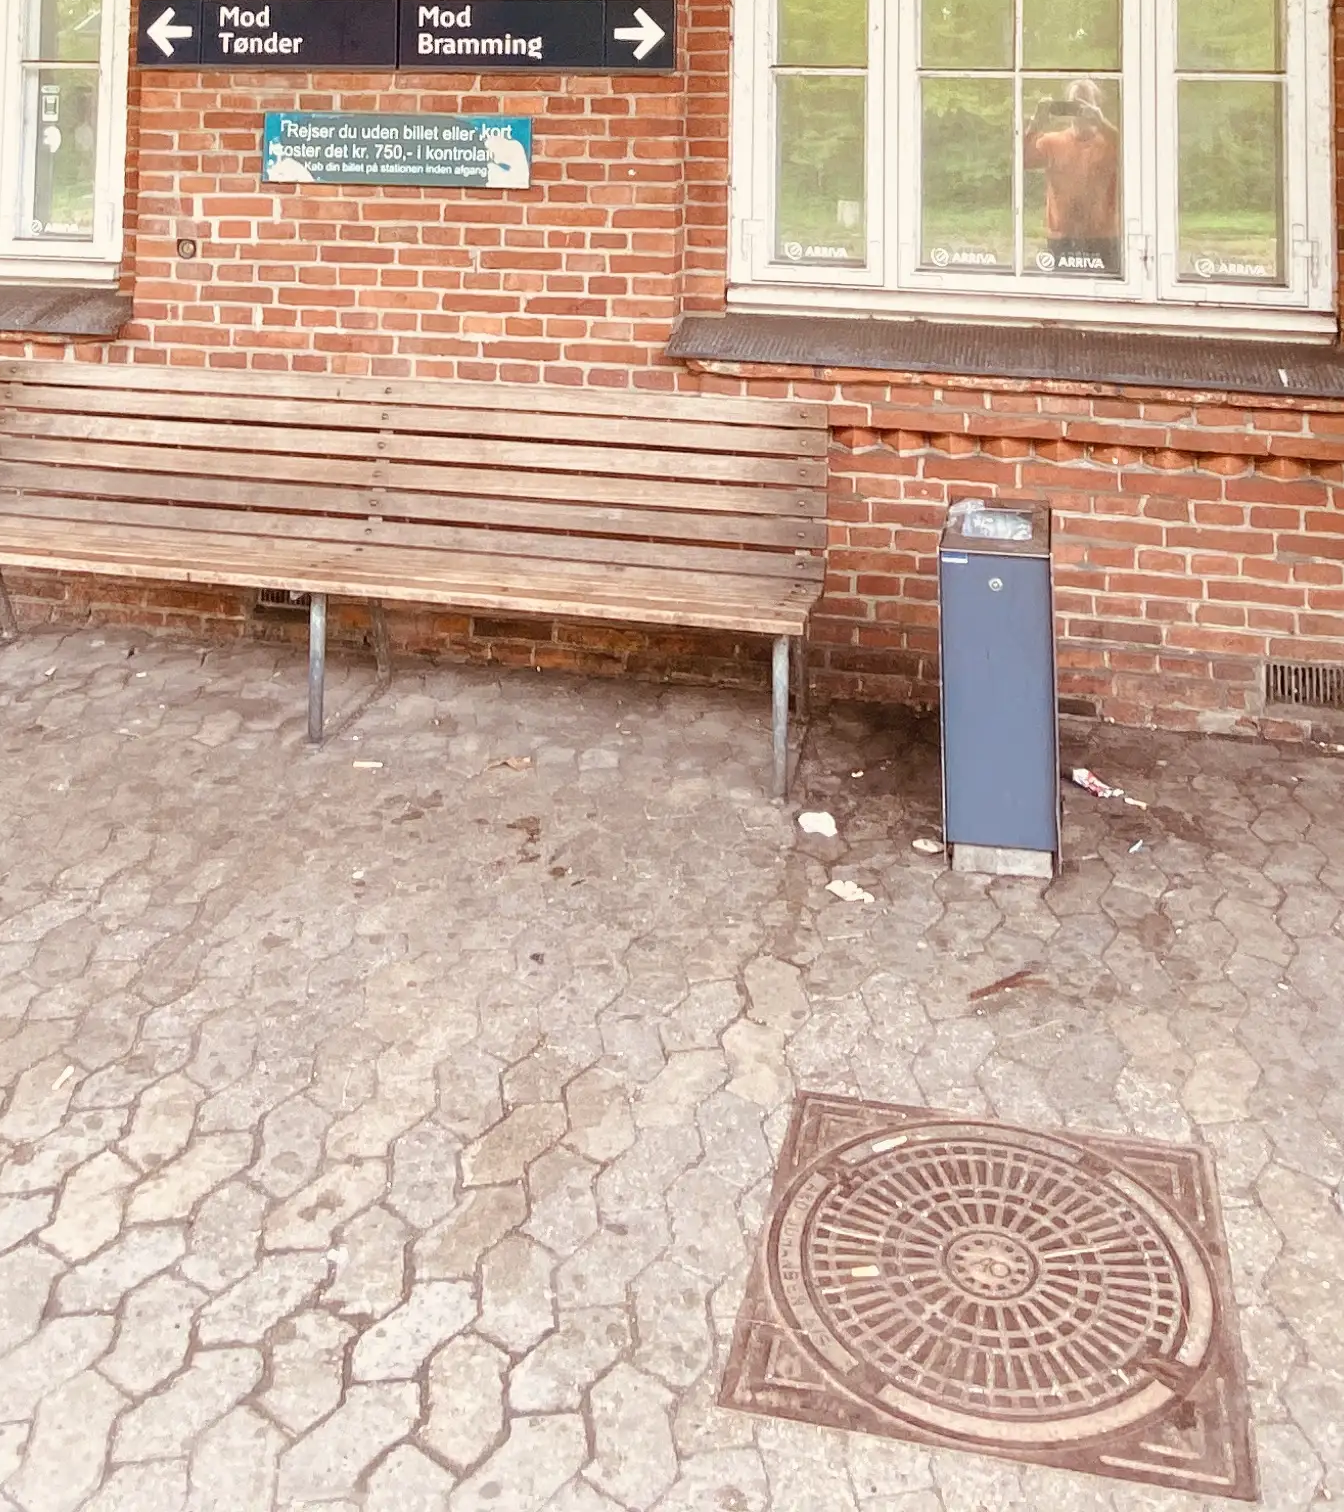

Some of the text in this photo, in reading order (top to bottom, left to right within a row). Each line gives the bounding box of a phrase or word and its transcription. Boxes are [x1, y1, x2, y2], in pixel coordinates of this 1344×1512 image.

[218, 5, 270, 28] Mod
[418, 5, 472, 29] Mod
[218, 31, 303, 55] Tønder
[417, 32, 543, 59] Bramming
[286, 122, 336, 141] Rejser
[338, 124, 358, 139] du
[361, 125, 399, 140] uden
[403, 124, 439, 140] billet
[442, 125, 475, 141] eller
[324, 143, 348, 158] det
[352, 144, 370, 159] kr.
[374, 144, 413, 162] 750,-
[416, 144, 422, 159] i
[324, 161, 341, 172] din
[342, 161, 365, 173] billet
[366, 161, 379, 175] på
[380, 163, 424, 174] stationen
[425, 164, 452, 175] inden
[805, 246, 849, 258] ARRIVA
[951, 252, 997, 265] ARRIVA
[1057, 256, 1105, 269] ARRIVA
[1218, 263, 1267, 277] ARRIVA
